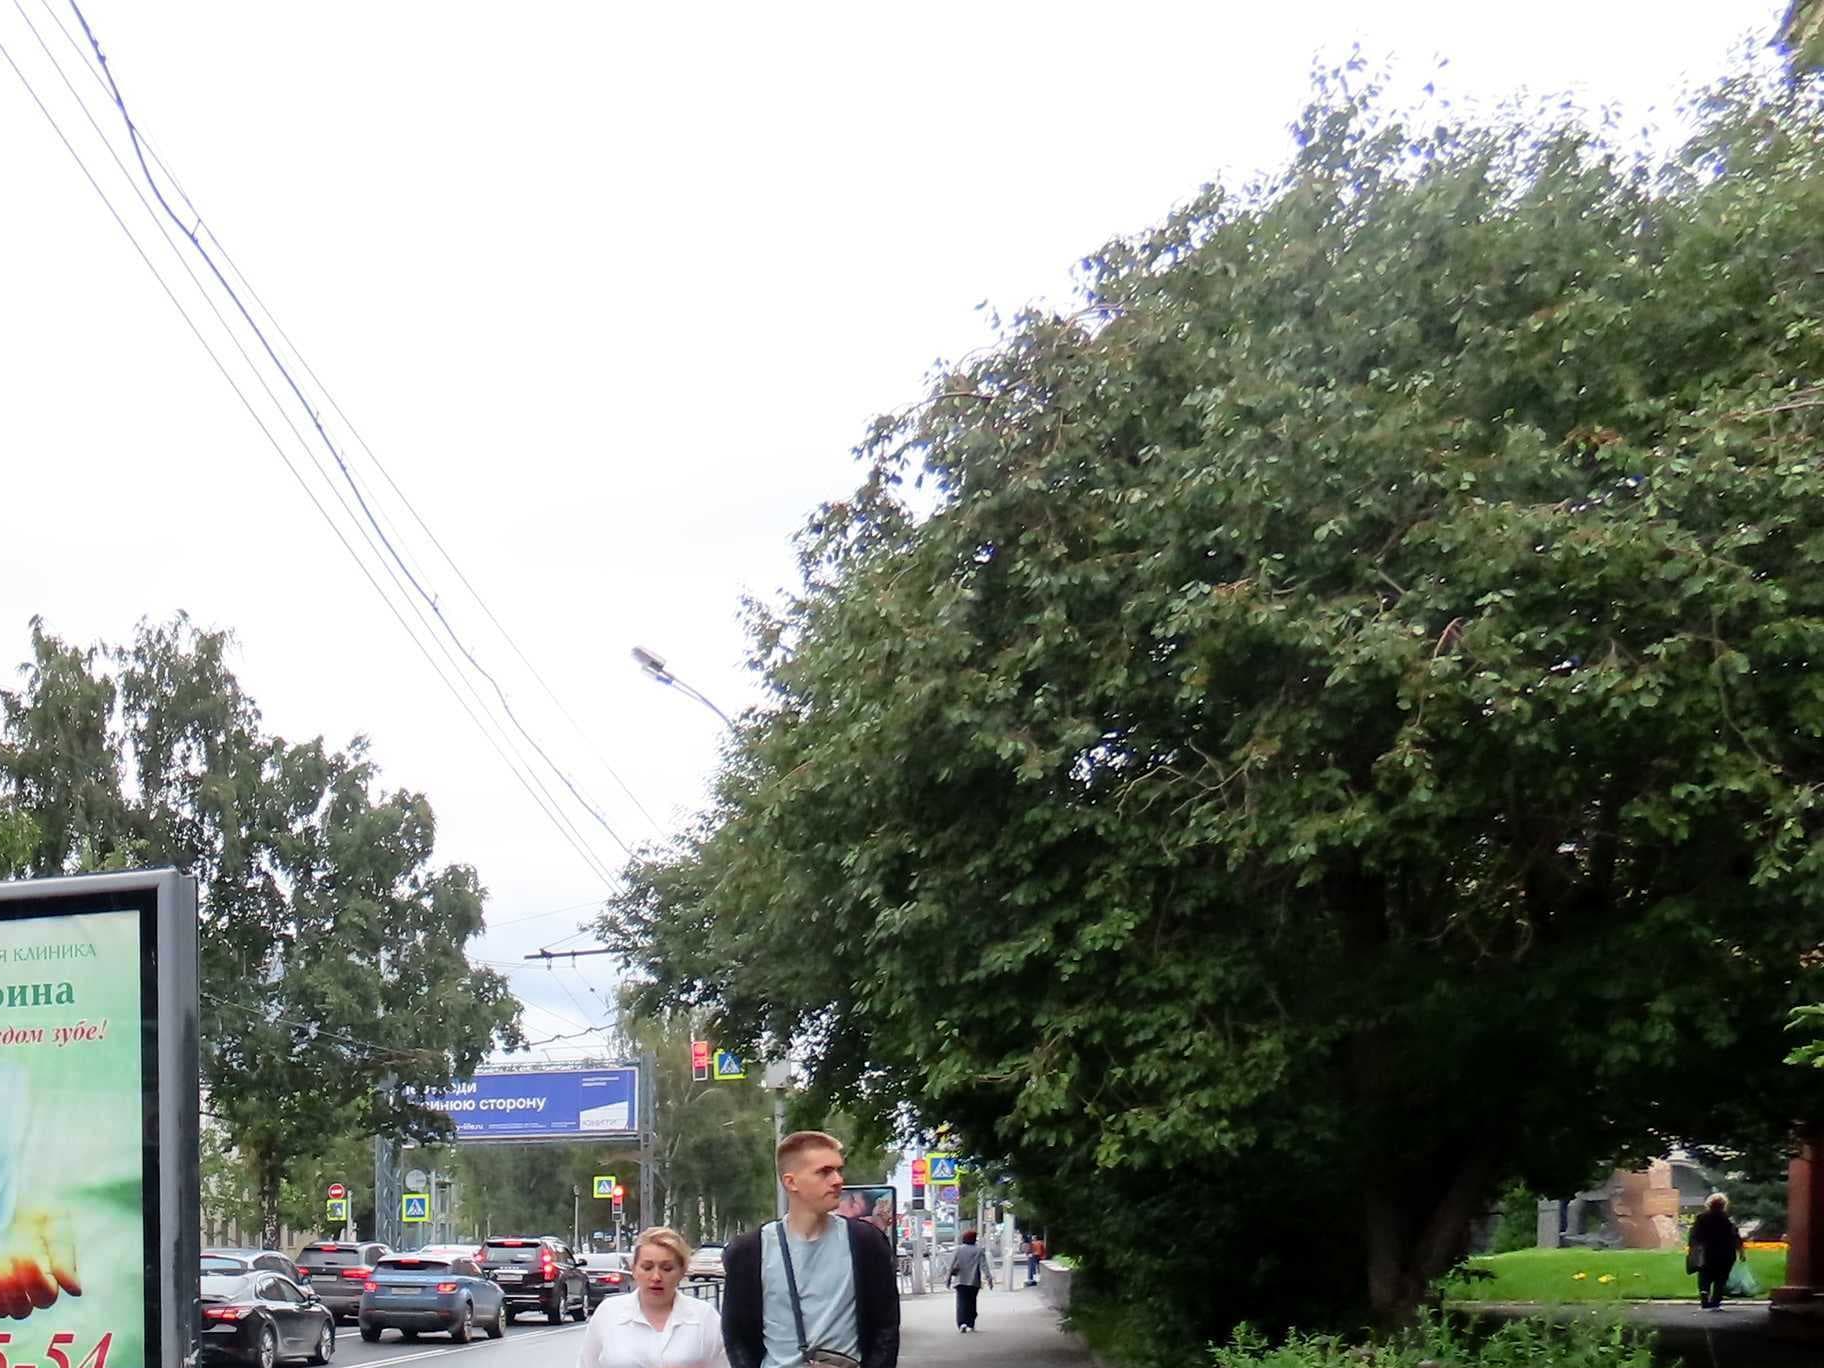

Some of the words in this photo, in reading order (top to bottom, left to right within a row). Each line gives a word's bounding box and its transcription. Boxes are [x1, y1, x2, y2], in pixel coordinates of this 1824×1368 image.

[13, 943, 97, 963] КЛИНИКА
[51, 1019, 108, 1047] зубе!
[480, 1097, 546, 1113] сторону
